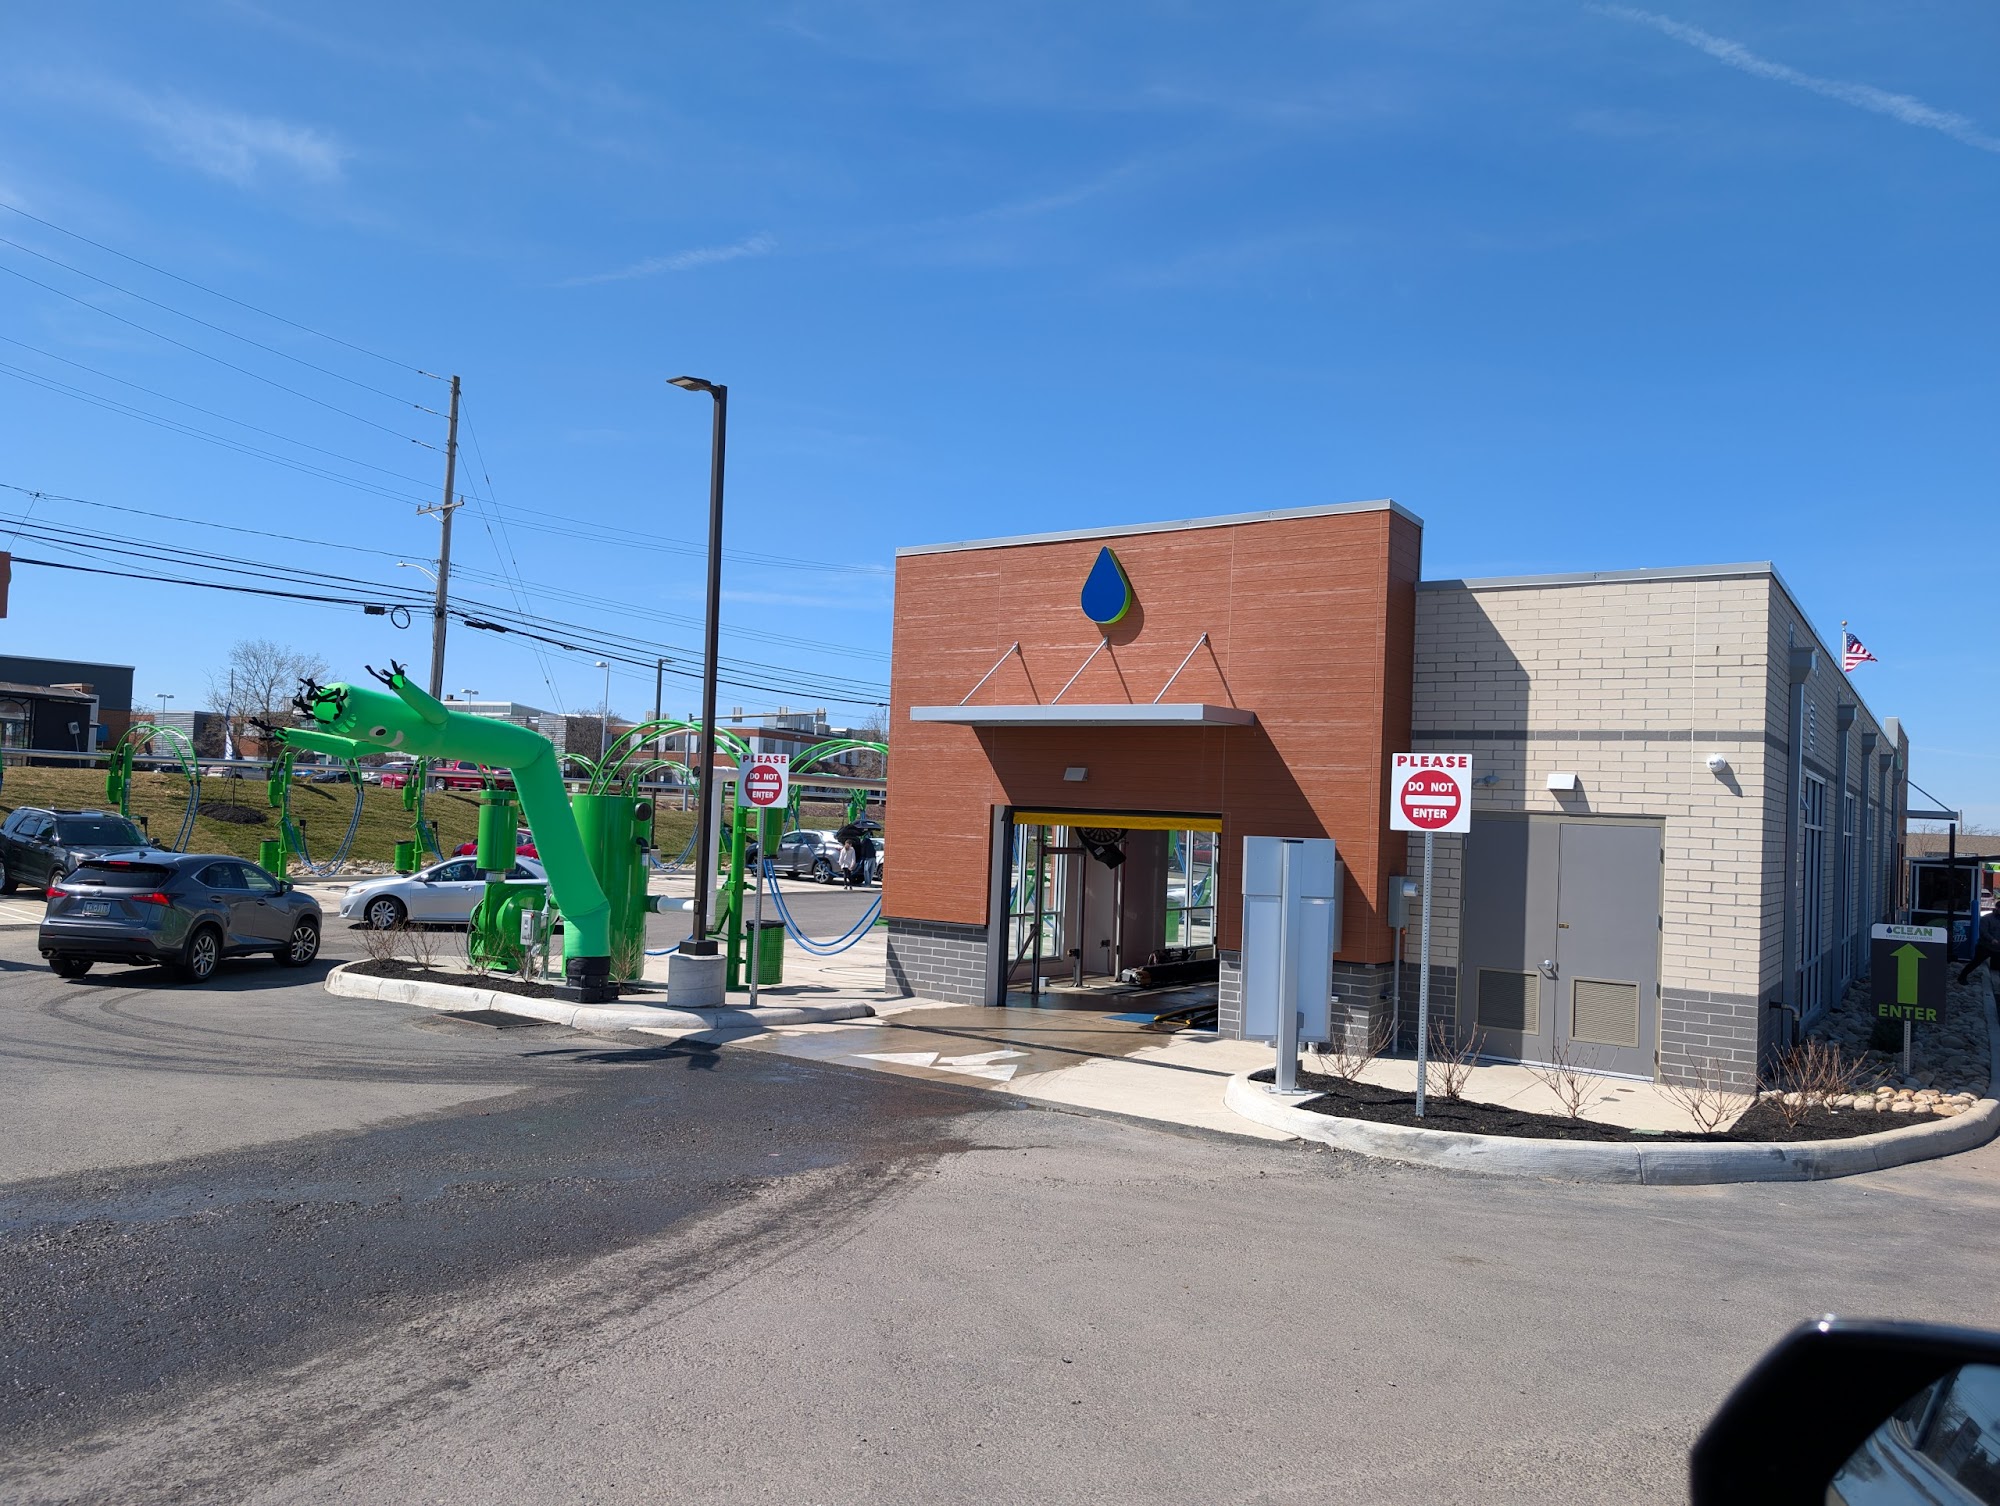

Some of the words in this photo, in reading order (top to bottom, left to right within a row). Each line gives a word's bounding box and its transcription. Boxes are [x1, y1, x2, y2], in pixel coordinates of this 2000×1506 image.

[742, 755, 787, 764] PLEASE
[1397, 755, 1468, 768] PLEASE
[1408, 781, 1425, 792] DO
[1430, 782, 1454, 792] NOT
[752, 791, 774, 799] ENTER
[1412, 808, 1448, 819] ENTER
[1892, 925, 1933, 937] CLEAN
[1878, 1003, 1937, 1021] ENTER
